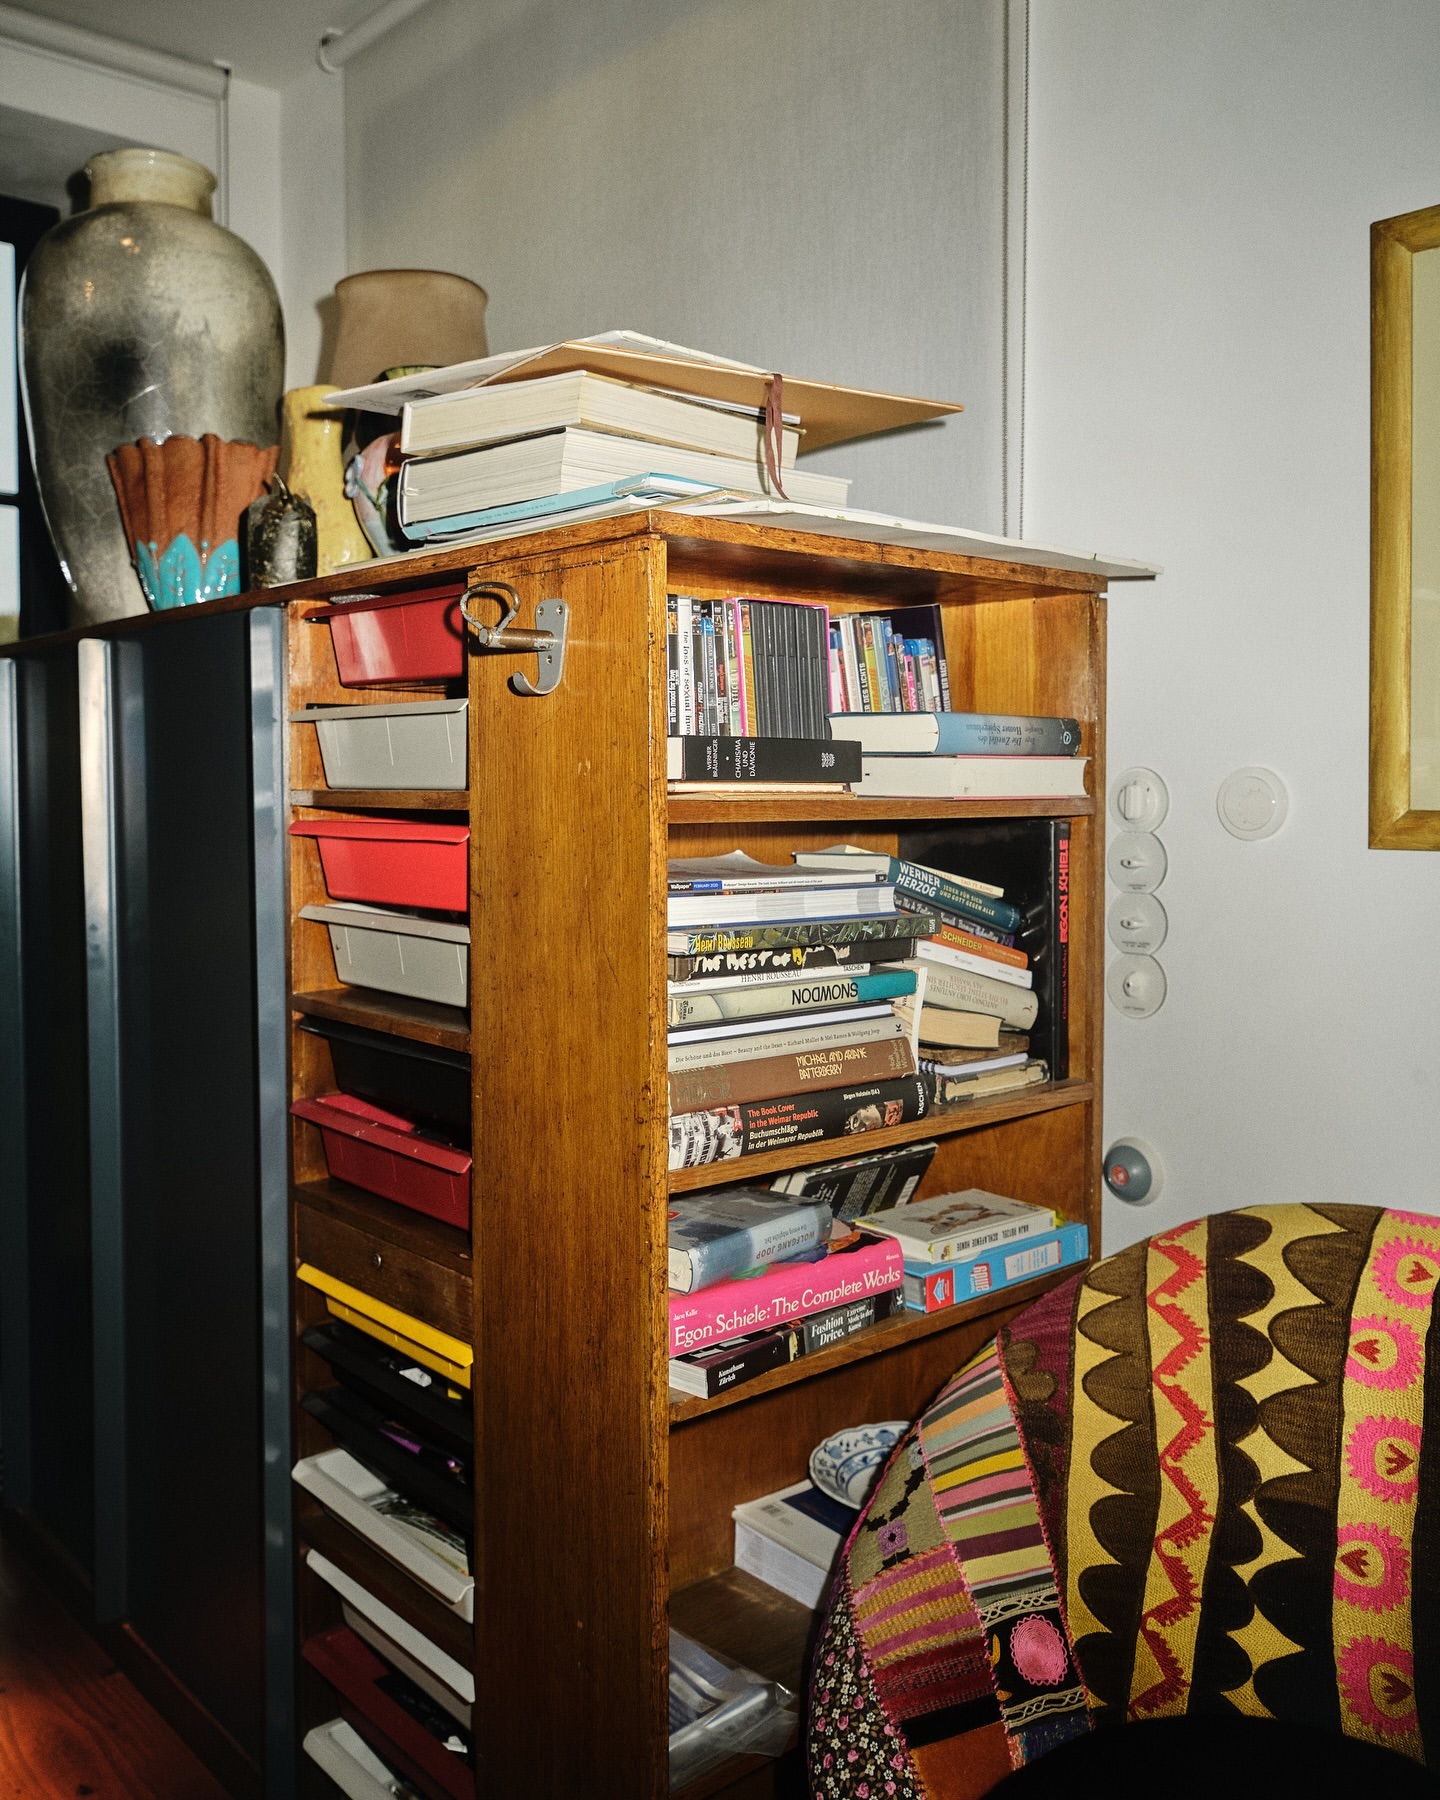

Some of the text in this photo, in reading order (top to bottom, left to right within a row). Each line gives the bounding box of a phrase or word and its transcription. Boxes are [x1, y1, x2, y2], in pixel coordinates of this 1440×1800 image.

[896, 874, 937, 898] HERZOG
[900, 862, 940, 888] WERNER
[1059, 840, 1069, 944] EGON SCHIELE
[696, 936, 716, 952] Henri
[942, 930, 983, 952] SCHNEIDER
[792, 982, 858, 1005] SNOWDON
[916, 1082, 924, 1115] TASCHEN
[748, 1104, 795, 1118] The Book Cover
[749, 1110, 819, 1128] in the Weimar Republic
[748, 1128, 824, 1150] in der Weimarer Republik
[749, 1124, 798, 1140] Buchumschläge
[756, 1244, 777, 1260] JOOP
[673, 1312, 684, 1322] Jane
[674, 1267, 901, 1348] Egon Schiele: The Complete Works
[811, 1316, 844, 1338] Fashion
[819, 1328, 845, 1346] Drive.
